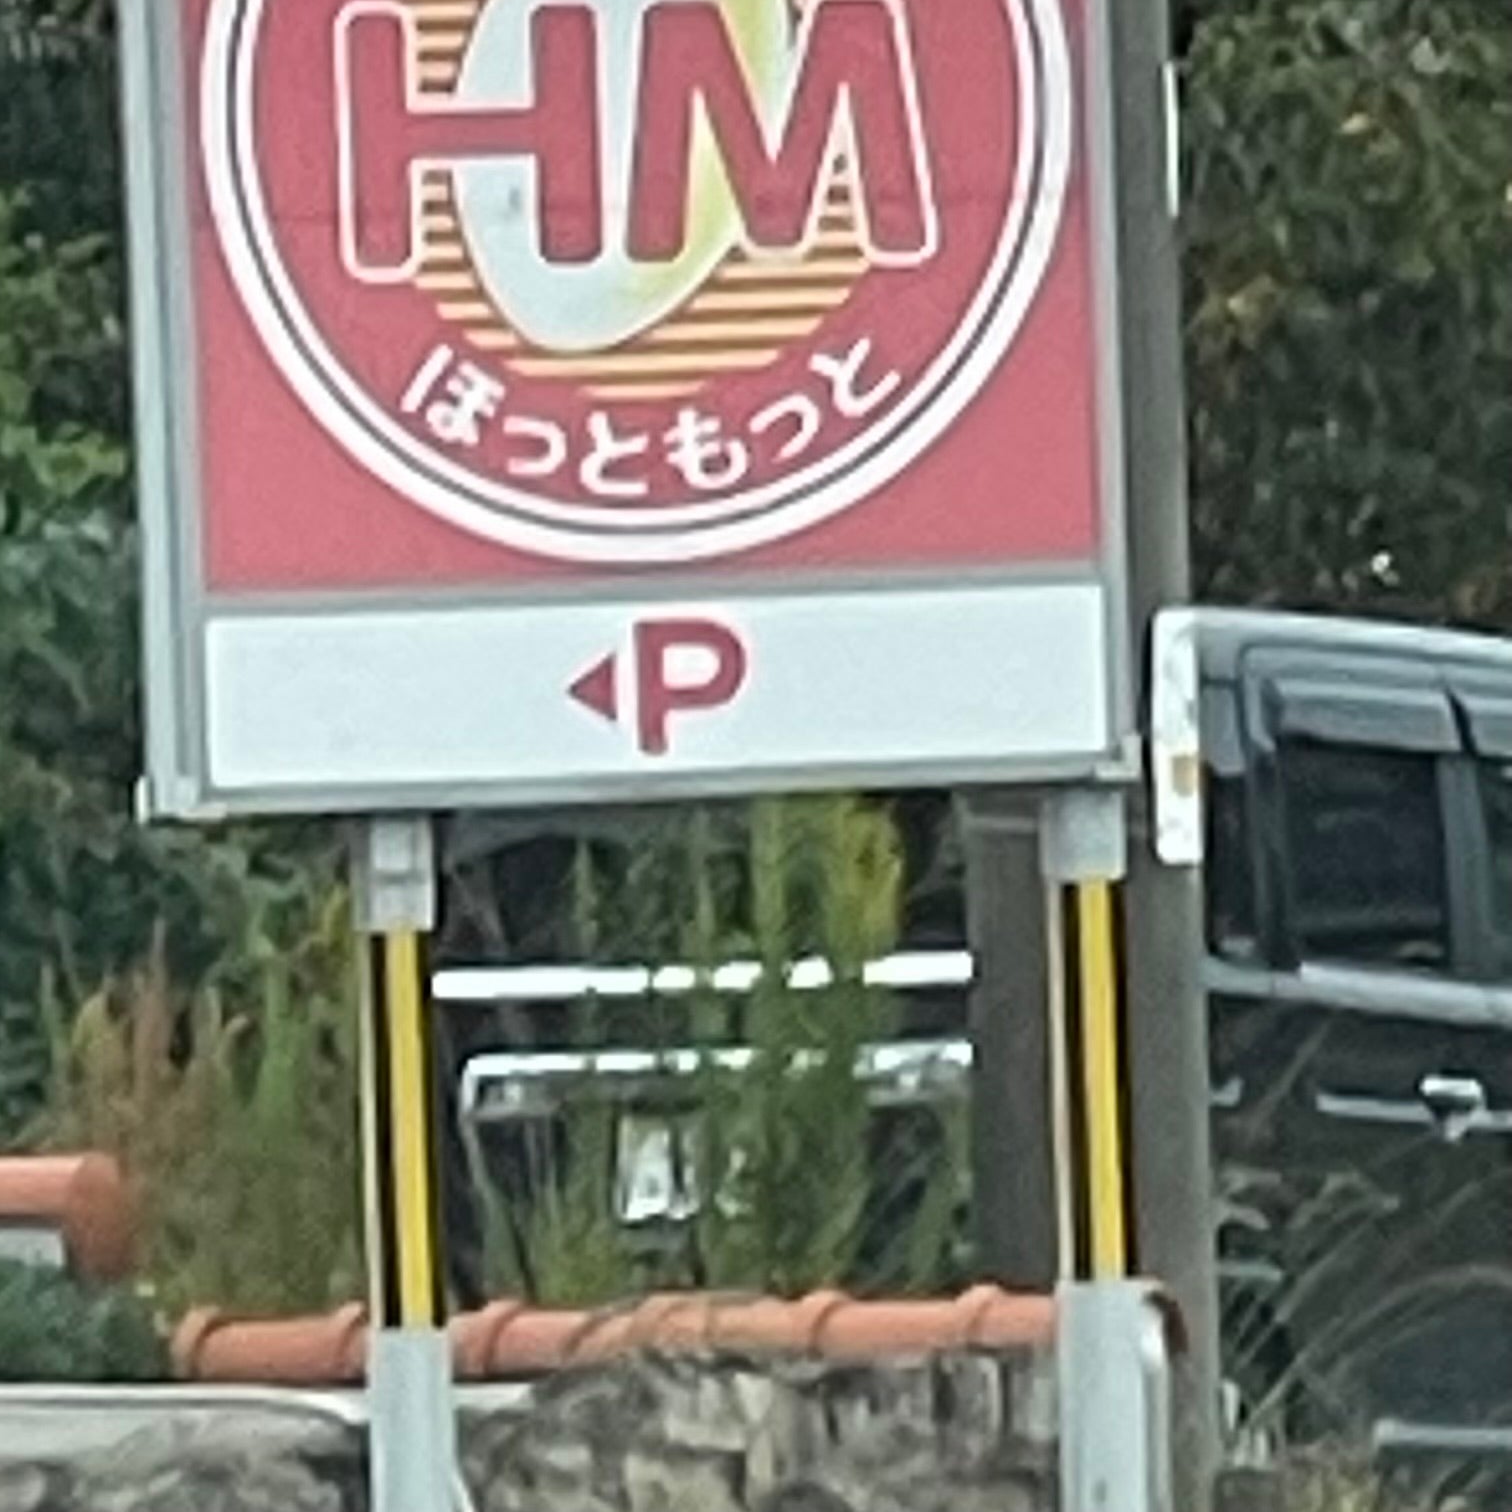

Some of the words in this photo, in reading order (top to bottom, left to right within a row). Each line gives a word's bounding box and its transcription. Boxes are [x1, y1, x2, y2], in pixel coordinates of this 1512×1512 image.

[404, 342, 897, 492] ほっともっと
[634, 619, 748, 751] P
